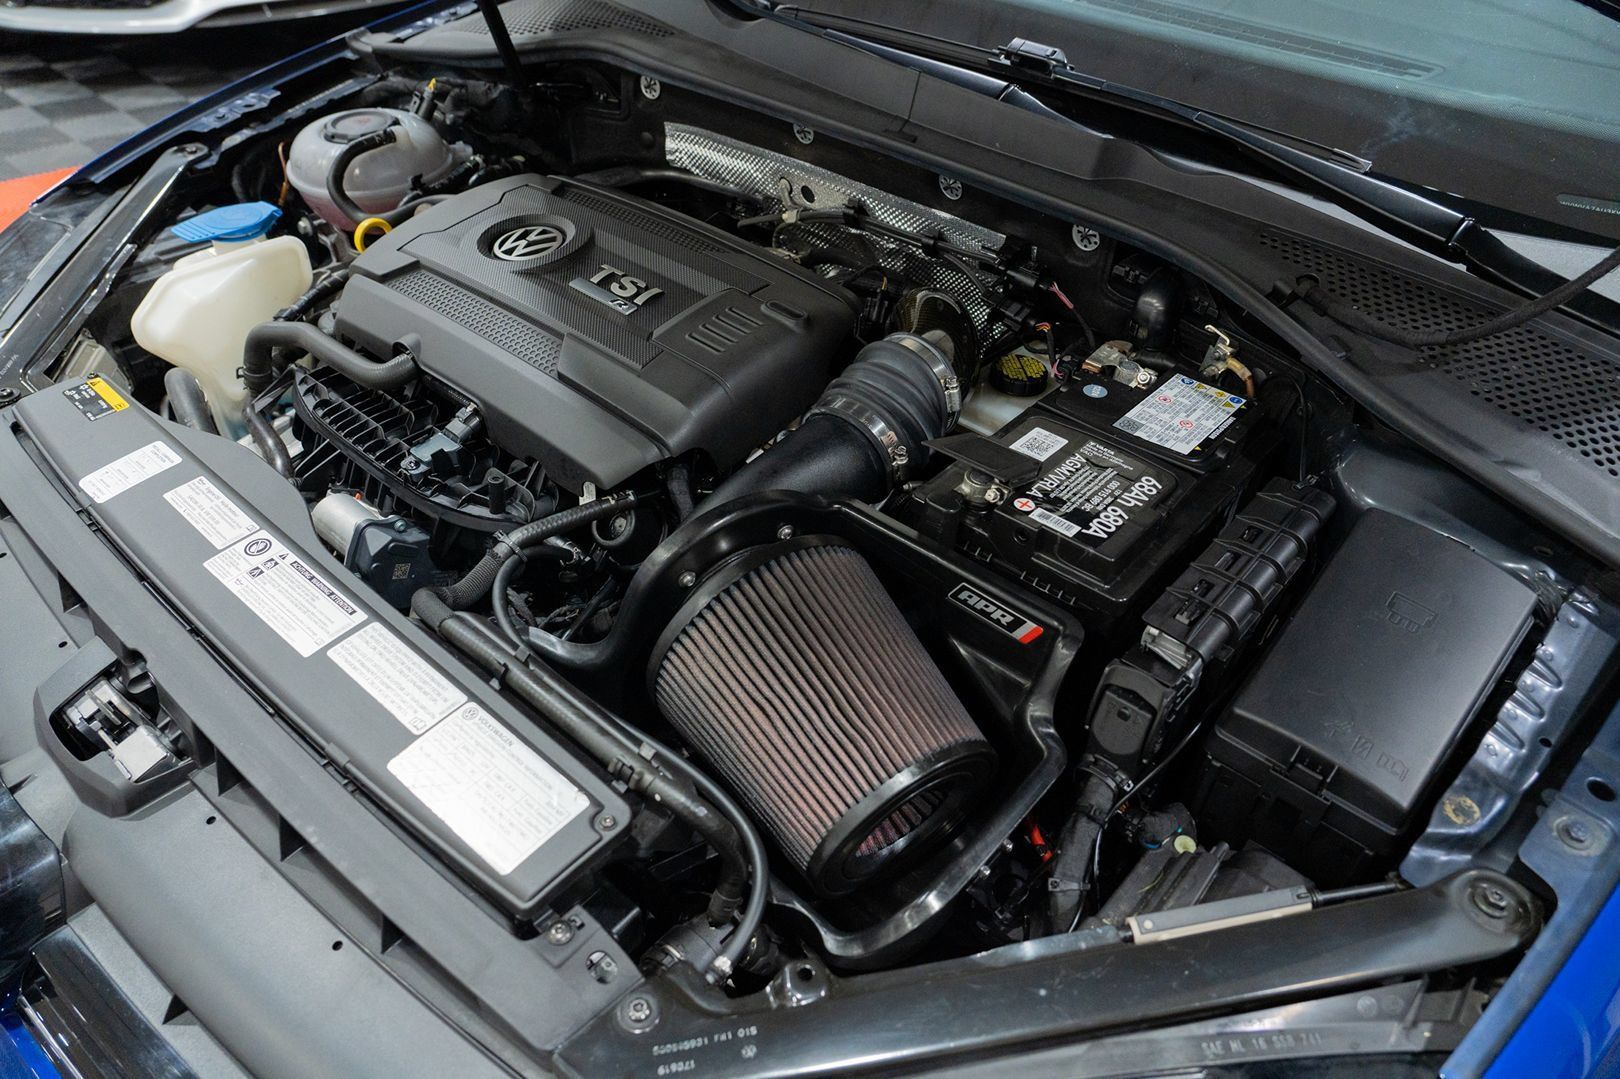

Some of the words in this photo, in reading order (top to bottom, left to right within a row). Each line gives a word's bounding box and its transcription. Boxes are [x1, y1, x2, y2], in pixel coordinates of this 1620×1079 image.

[590, 264, 665, 306] TSI
[1025, 453, 1088, 500] AGM/VRLA
[1098, 488, 1112, 498] 915
[1107, 480, 1121, 490] 000
[1121, 475, 1163, 508] 68Ah
[1081, 502, 1130, 539] 680A
[291, 561, 313, 579] ACHTUNG
[310, 577, 331, 595] WARNING
[329, 593, 354, 614] ATTENTION
[957, 590, 1015, 626] APR
[476, 714, 515, 748] VOLKSWAGEN
